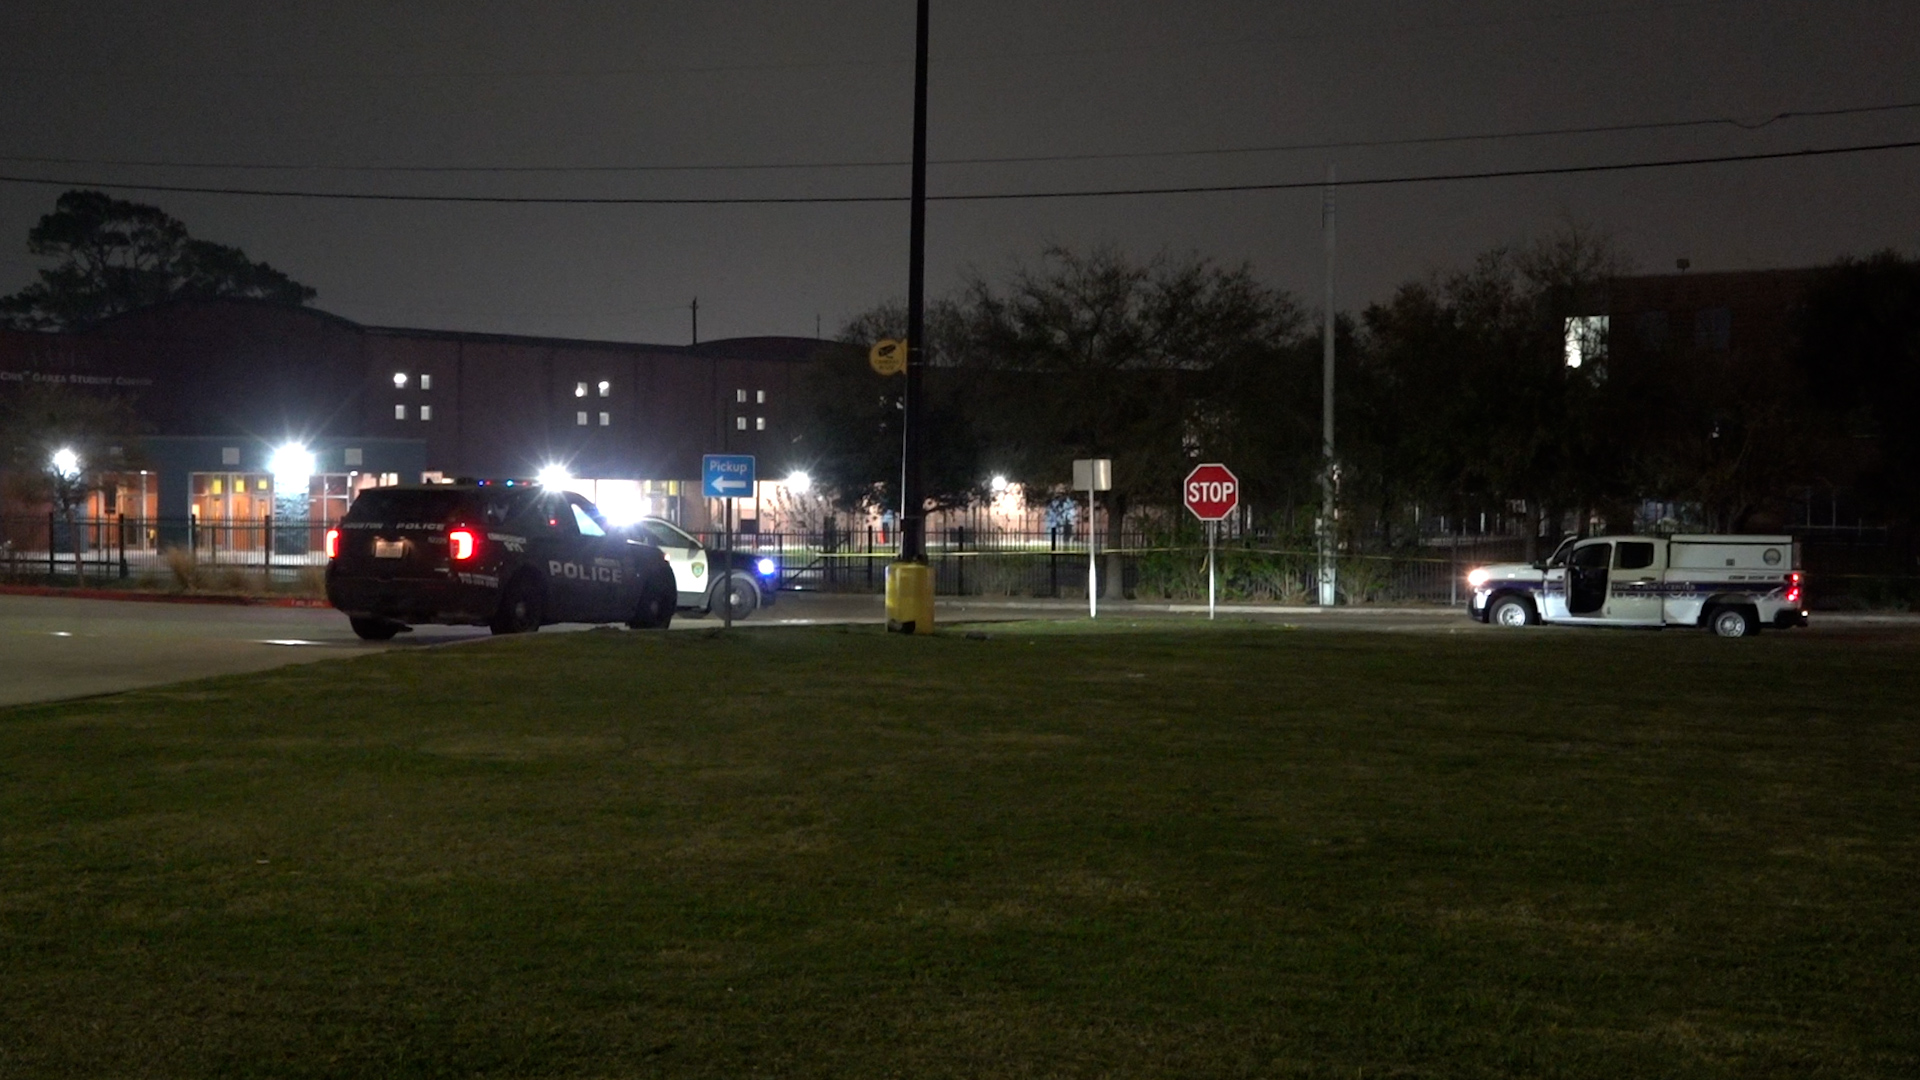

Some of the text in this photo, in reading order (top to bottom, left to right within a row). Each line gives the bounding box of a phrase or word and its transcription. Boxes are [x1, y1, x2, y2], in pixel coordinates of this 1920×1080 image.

[69, 374, 112, 385] STUDENT
[709, 460, 748, 475] Pickup
[1188, 481, 1235, 503] STOP
[395, 522, 446, 531] POLICE
[548, 559, 623, 584] POLICE
